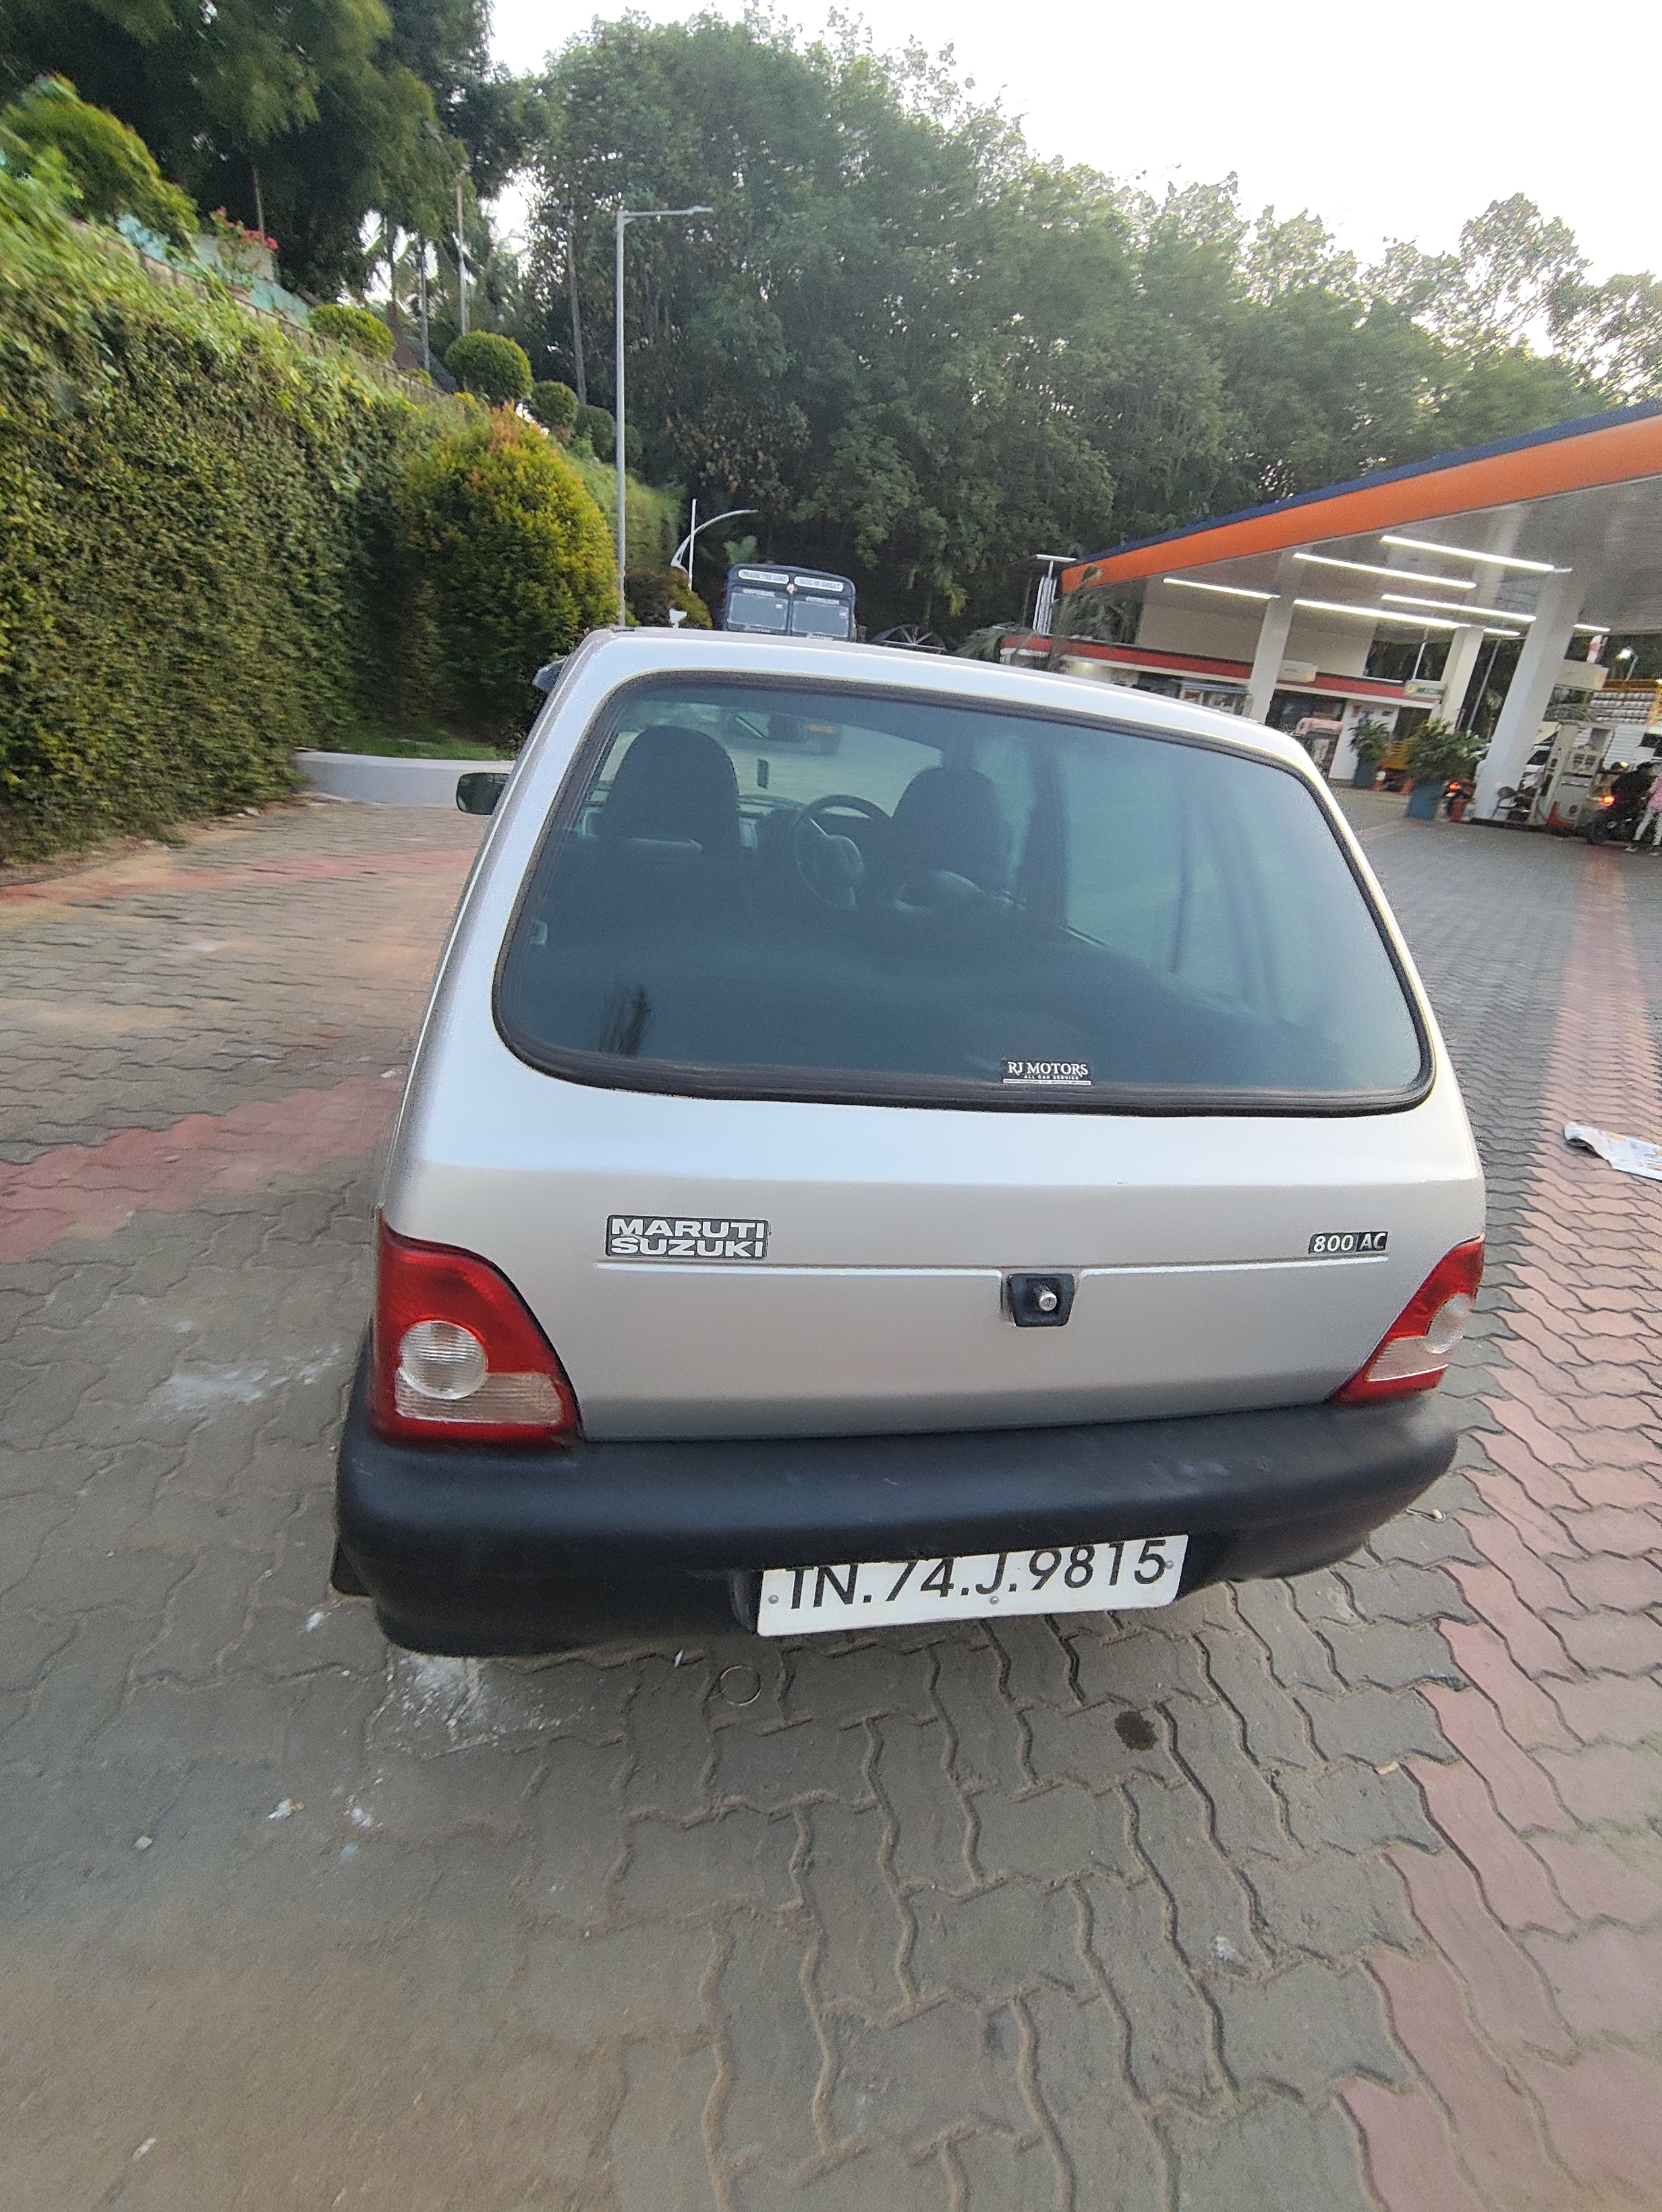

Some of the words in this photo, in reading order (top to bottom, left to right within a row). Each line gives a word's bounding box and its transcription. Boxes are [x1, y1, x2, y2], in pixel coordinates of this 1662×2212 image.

[1007, 1062, 1023, 1076] RJ
[1026, 1062, 1089, 1078] MOTORS
[611, 1218, 764, 1239] MARUTI
[610, 1237, 763, 1257] SUZUKI
[1313, 1235, 1354, 1252] 800
[1360, 1233, 1386, 1251] AC
